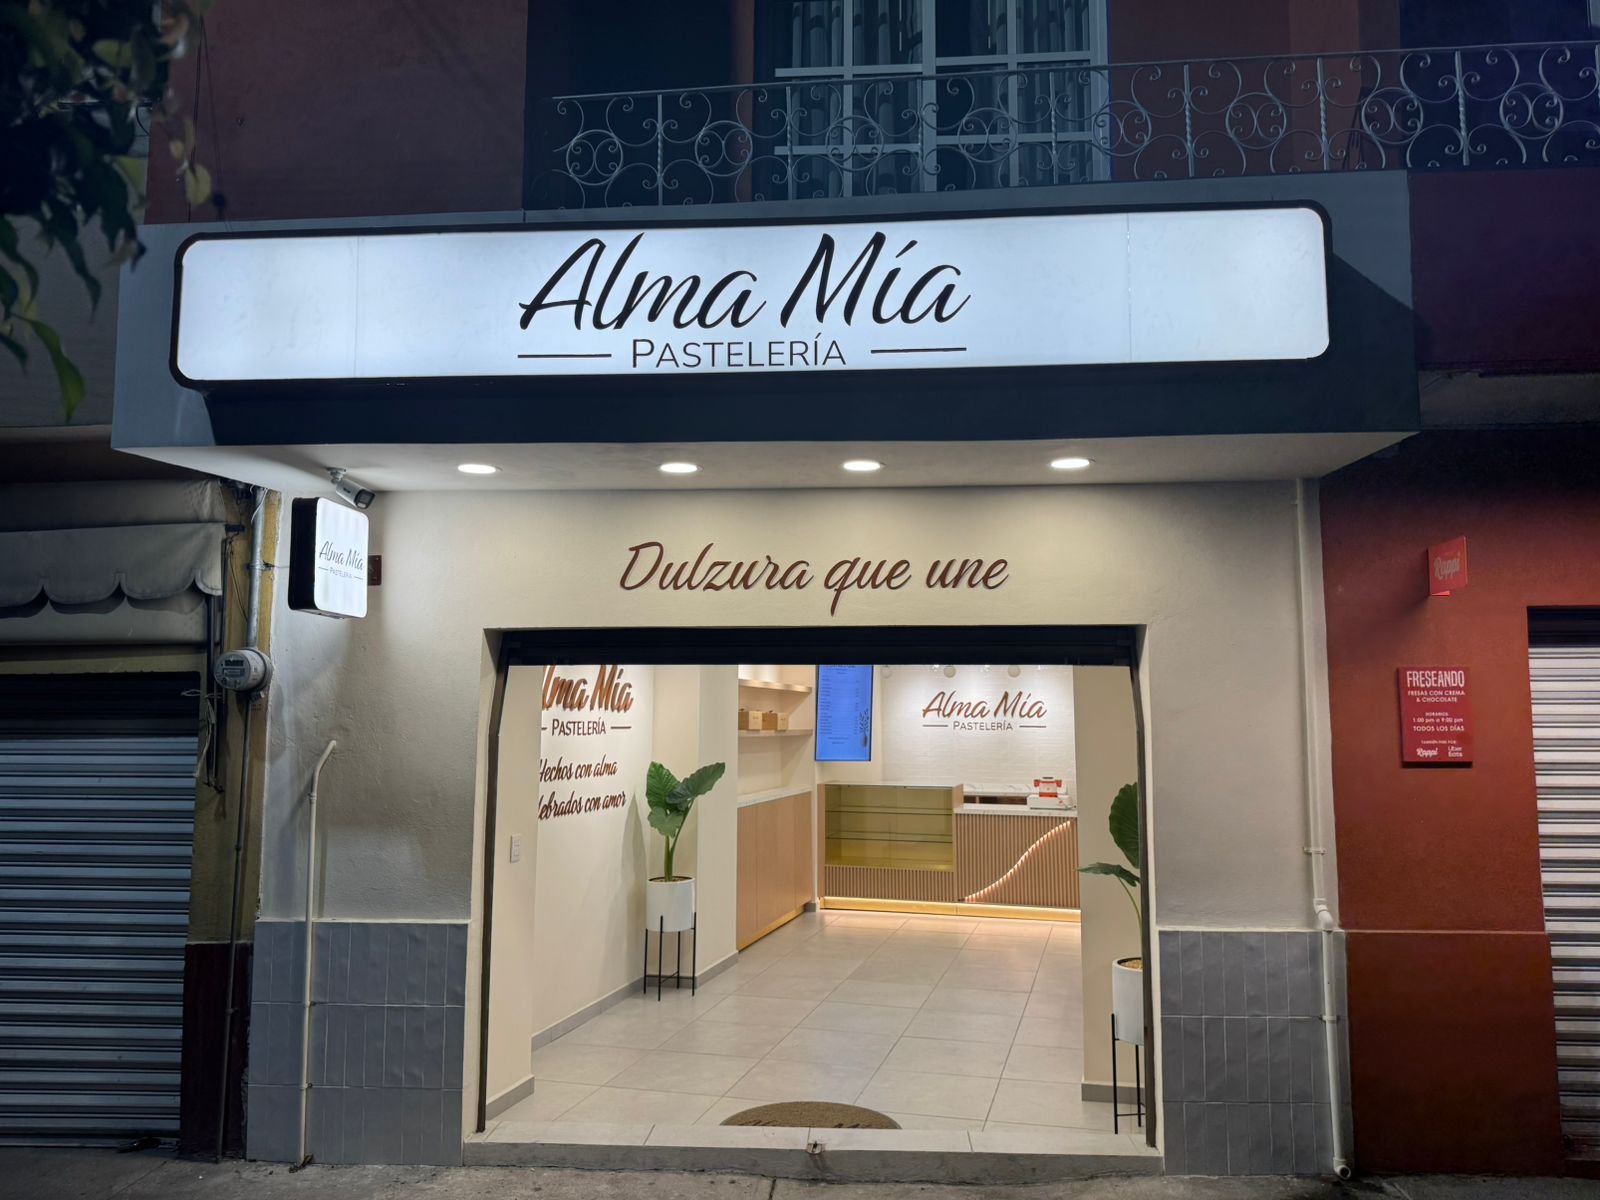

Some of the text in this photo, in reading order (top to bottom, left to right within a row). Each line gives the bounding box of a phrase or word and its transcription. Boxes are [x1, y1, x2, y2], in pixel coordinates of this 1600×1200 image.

[518, 231, 972, 330] Alma Mía
[632, 333, 847, 369] PASTELERÍA
[318, 540, 365, 571] Alma Mía
[619, 541, 1010, 617] Dulzura que une
[541, 665, 634, 713] lma Mía
[1406, 670, 1465, 688] FRESEANDO
[921, 690, 1048, 719] Alma Mía
[551, 717, 607, 737] PASTELERÍA
[1450, 724, 1465, 732] DÍAS
[1416, 746, 1439, 759] Rappi
[574, 764, 592, 780] con
[593, 754, 618, 778] alma
[584, 795, 602, 813] con
[602, 790, 627, 810] amor
